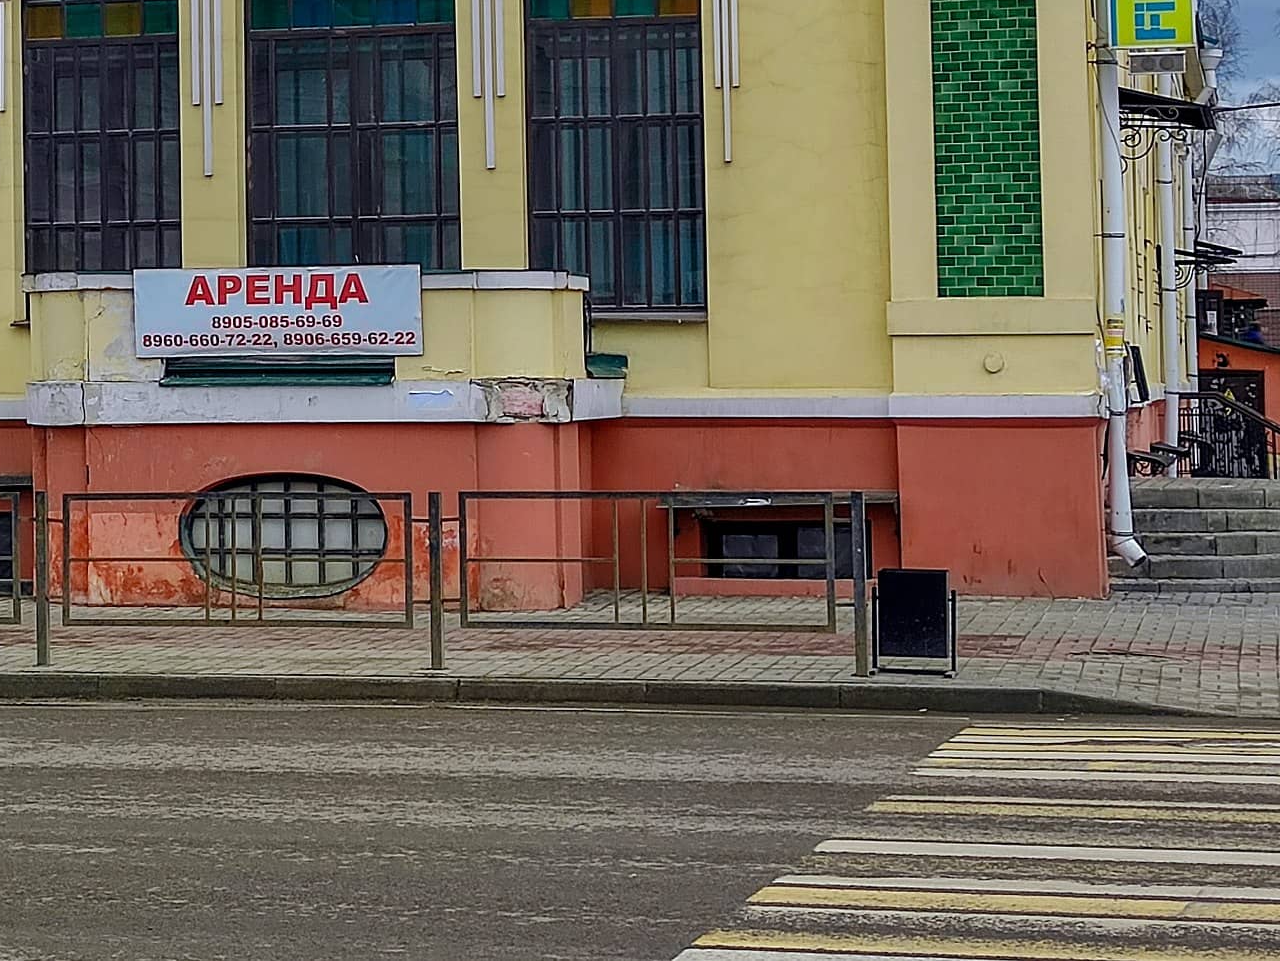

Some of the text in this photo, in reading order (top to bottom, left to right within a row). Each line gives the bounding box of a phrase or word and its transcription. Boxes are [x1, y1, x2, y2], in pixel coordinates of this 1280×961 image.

[185, 273, 369, 310] АРЕНДА
[211, 315, 343, 329] 8905-085-69-69
[142, 332, 416, 349] 8960-660-72-22, 8906-659-62-22
